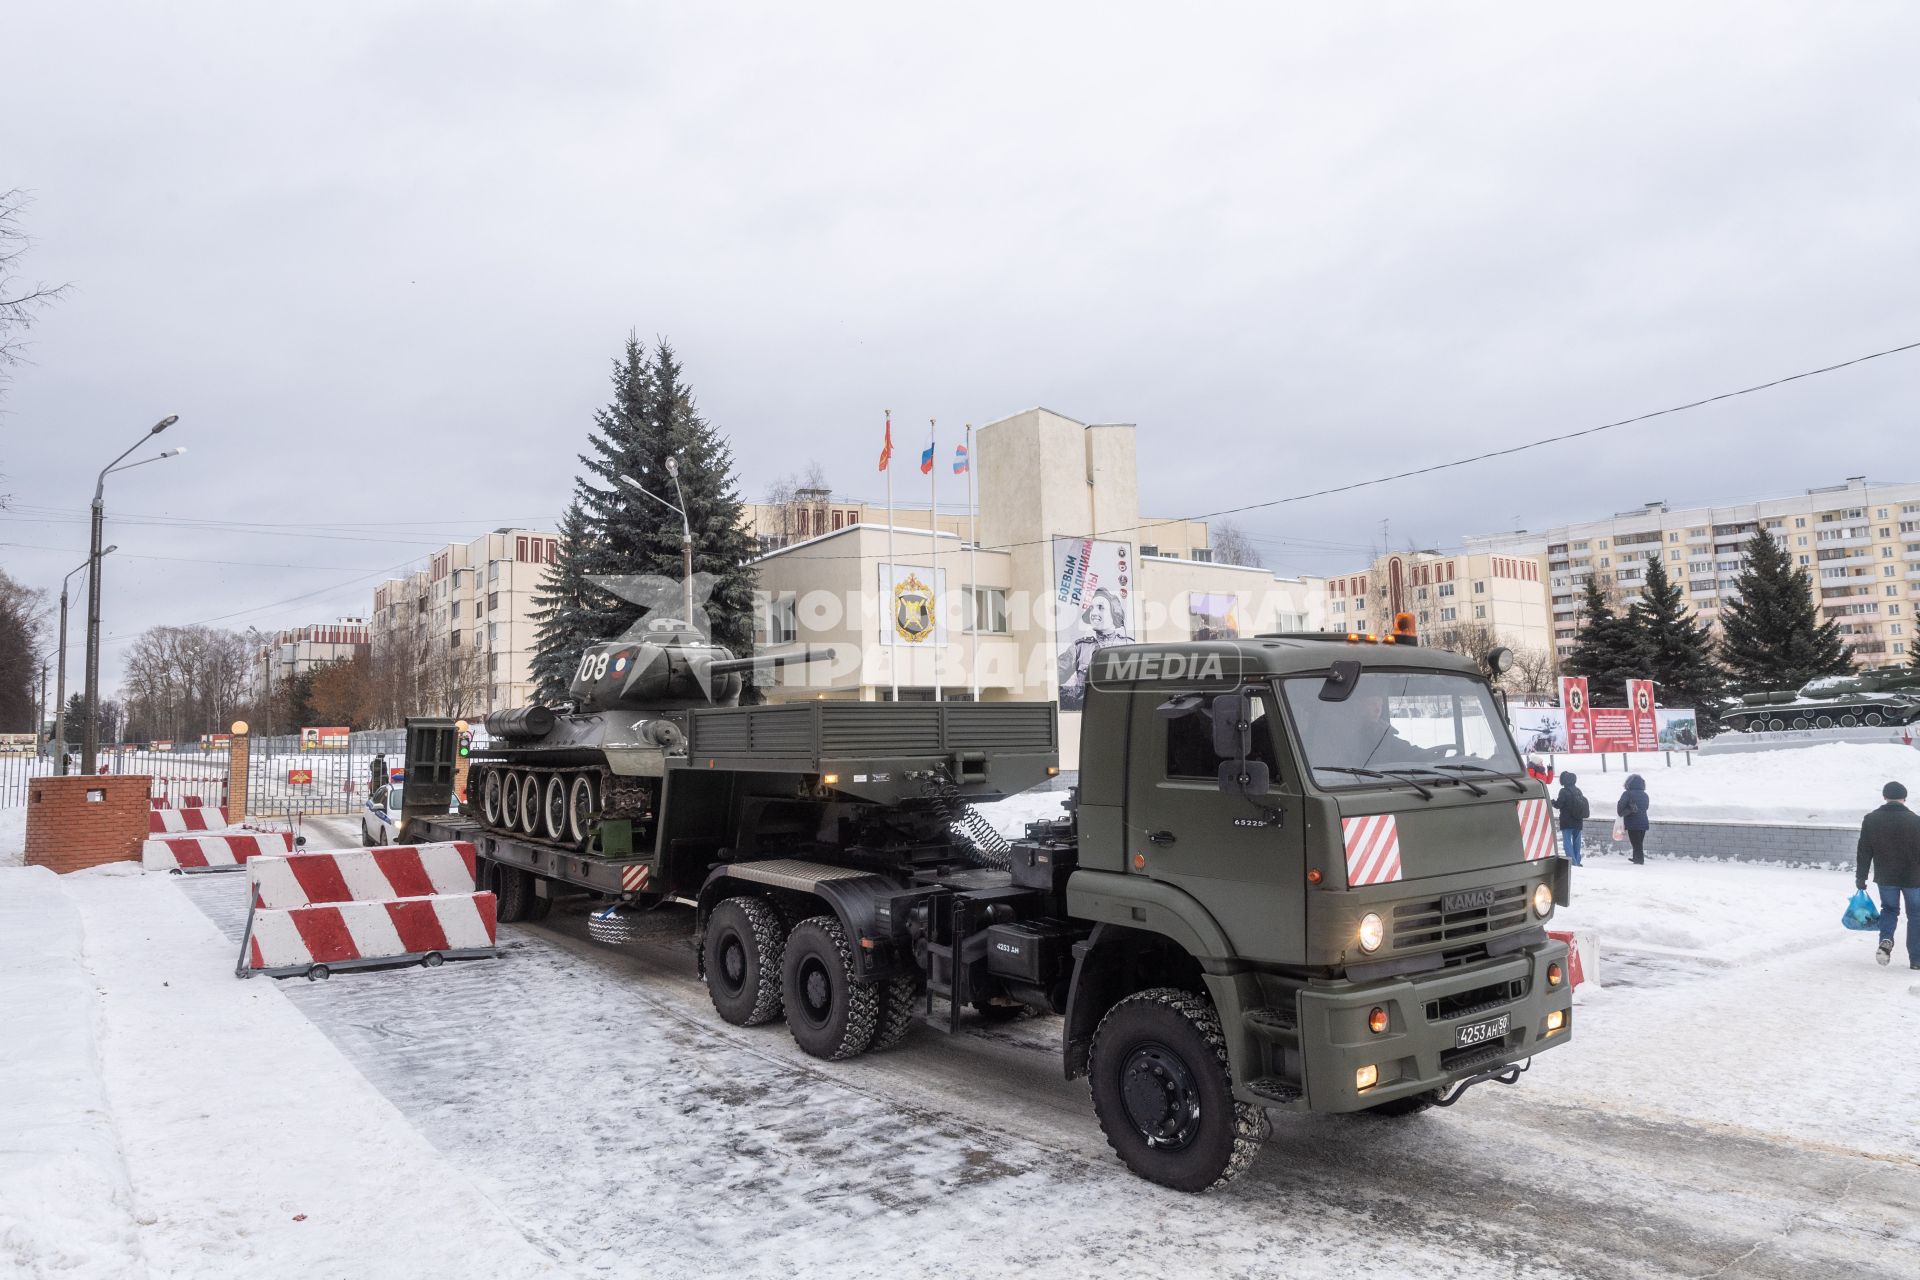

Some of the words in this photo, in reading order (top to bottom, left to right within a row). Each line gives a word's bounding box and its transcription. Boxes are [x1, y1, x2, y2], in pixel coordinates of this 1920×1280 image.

[1058, 554, 1077, 603] БОЕВЫМ
[1070, 538, 1094, 607] ТРАДИЦИЯМ
[1444, 890, 1494, 912] КАМАЗ
[997, 943, 1010, 952] 4253
[1460, 1024, 1486, 1044] 4253
[1486, 1024, 1498, 1038] АН
[1498, 1017, 1507, 1030] 50
